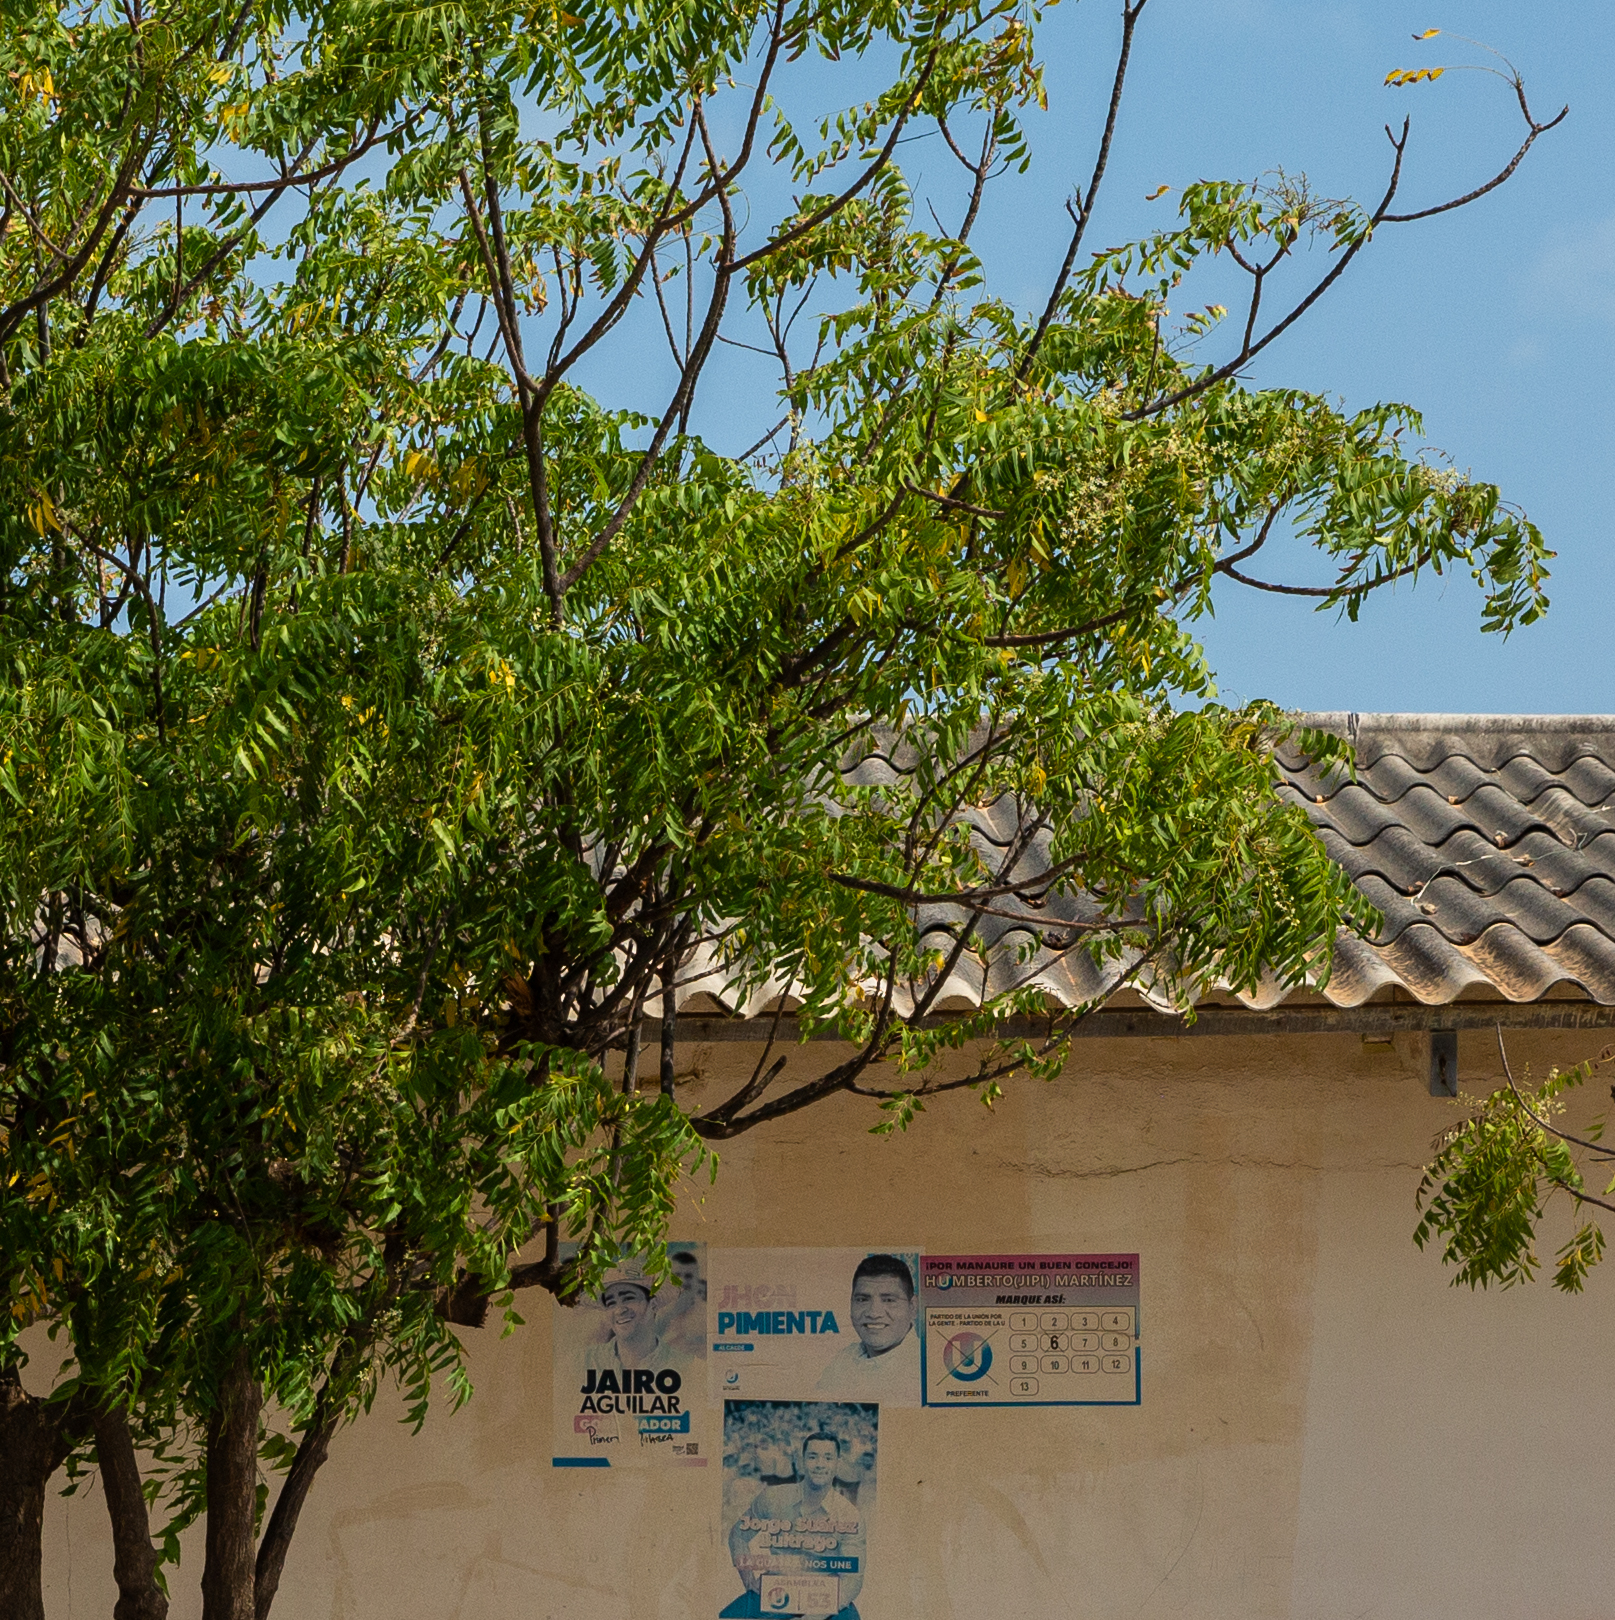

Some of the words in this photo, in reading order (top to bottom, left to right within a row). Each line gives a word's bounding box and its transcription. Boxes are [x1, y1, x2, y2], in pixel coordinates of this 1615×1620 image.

[925, 1261, 953, 1270] ¡POR
[956, 1261, 1015, 1270] MANAURE
[1018, 1261, 1034, 1270] UN
[1039, 1261, 1071, 1270] BUEN
[1075, 1260, 1133, 1270] CONCEJO!
[1055, 1271, 1133, 1286] MARTÍNEZ
[995, 1294, 1043, 1305] MARQUE
[1043, 1293, 1066, 1304] ASÍ:
[718, 1310, 840, 1335] PIMIENTA
[1022, 1317, 1027, 1326] 1
[1051, 1317, 1057, 1326] 2
[1082, 1317, 1087, 1326] 3
[1112, 1316, 1118, 1325] 4
[1021, 1339, 1027, 1348] 5
[1050, 1335, 1059, 1350] 6
[1082, 1338, 1087, 1347] 7
[1113, 1337, 1118, 1346] 8
[1021, 1361, 1027, 1370] 9
[1051, 1361, 1060, 1370] 10
[1082, 1360, 1090, 1369] 11
[1112, 1360, 1121, 1369] 12
[580, 1369, 681, 1394] JAIRO
[1020, 1382, 1029, 1391] 13
[580, 1395, 681, 1414] AGUILAR
[579, 1418, 681, 1431] GOADOR
[740, 1516, 792, 1535] Jorge
[805, 1559, 827, 1569] NOS
[830, 1560, 852, 1569] UNE
[807, 1592, 832, 1609] 53
